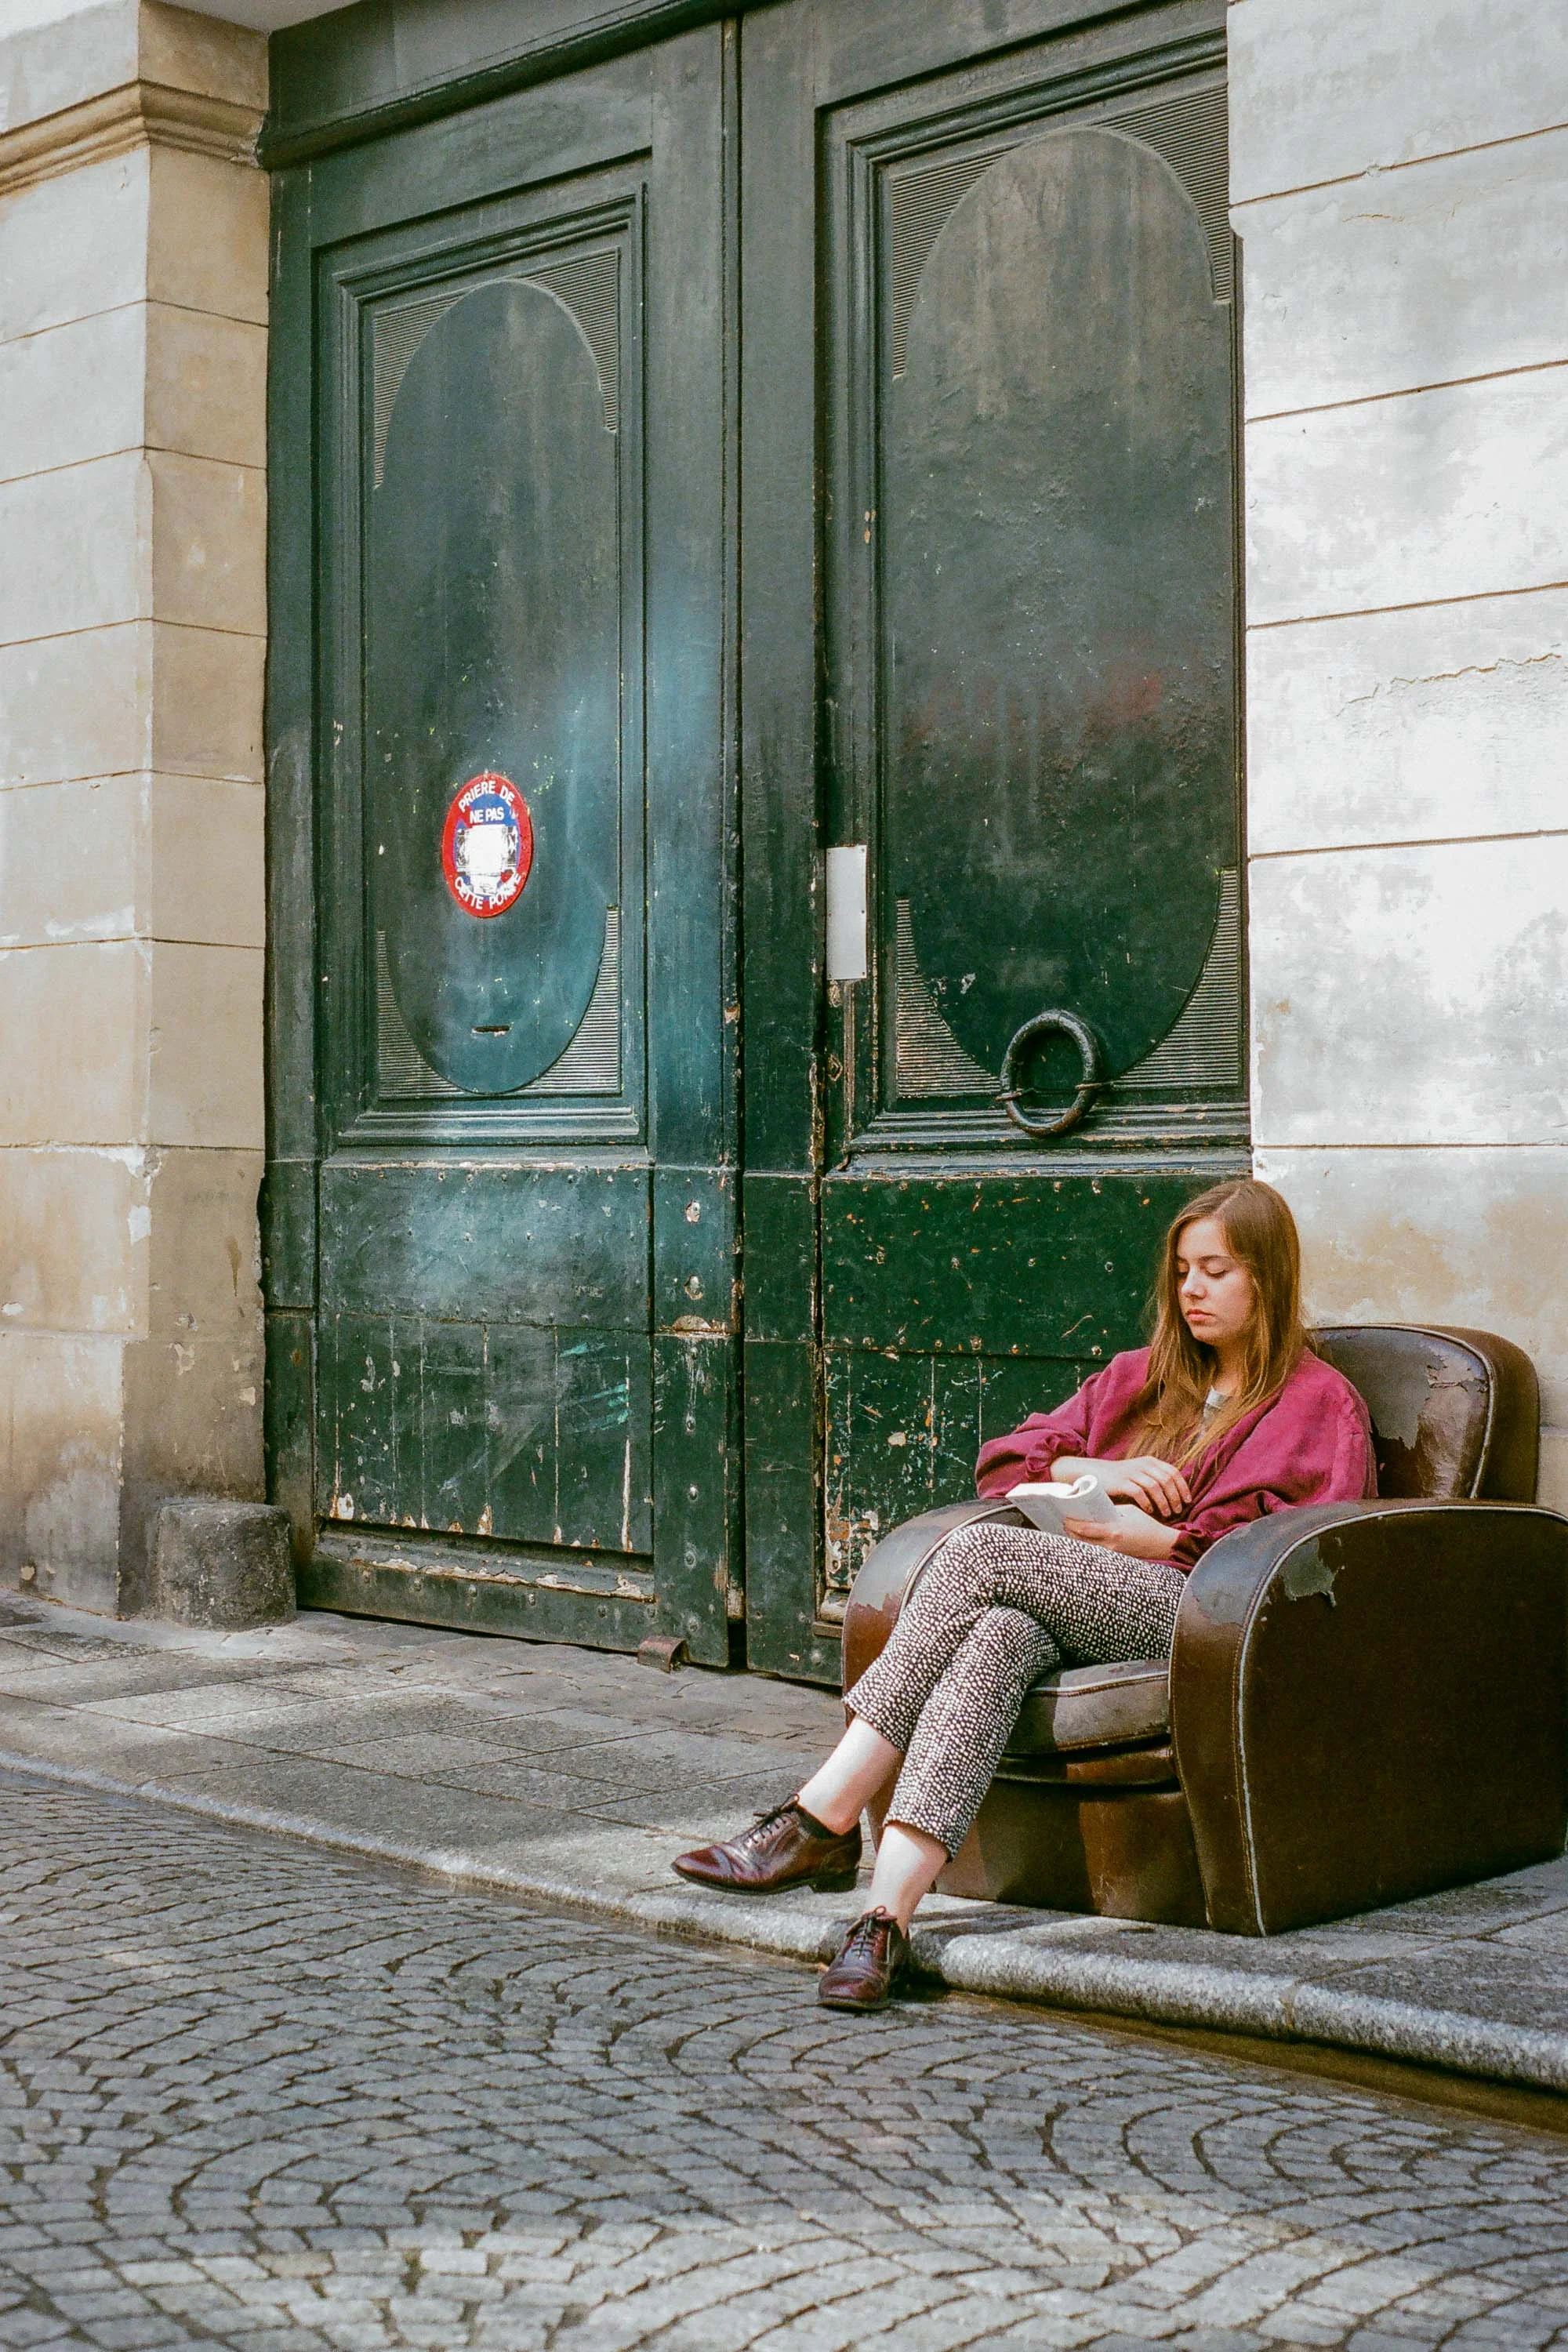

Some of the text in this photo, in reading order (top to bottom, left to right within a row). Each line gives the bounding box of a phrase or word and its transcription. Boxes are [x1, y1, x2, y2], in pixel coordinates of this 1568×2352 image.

[459, 780, 515, 813] PRIERE DE
[470, 807, 504, 823] NE PAS
[489, 873, 521, 909] POE
